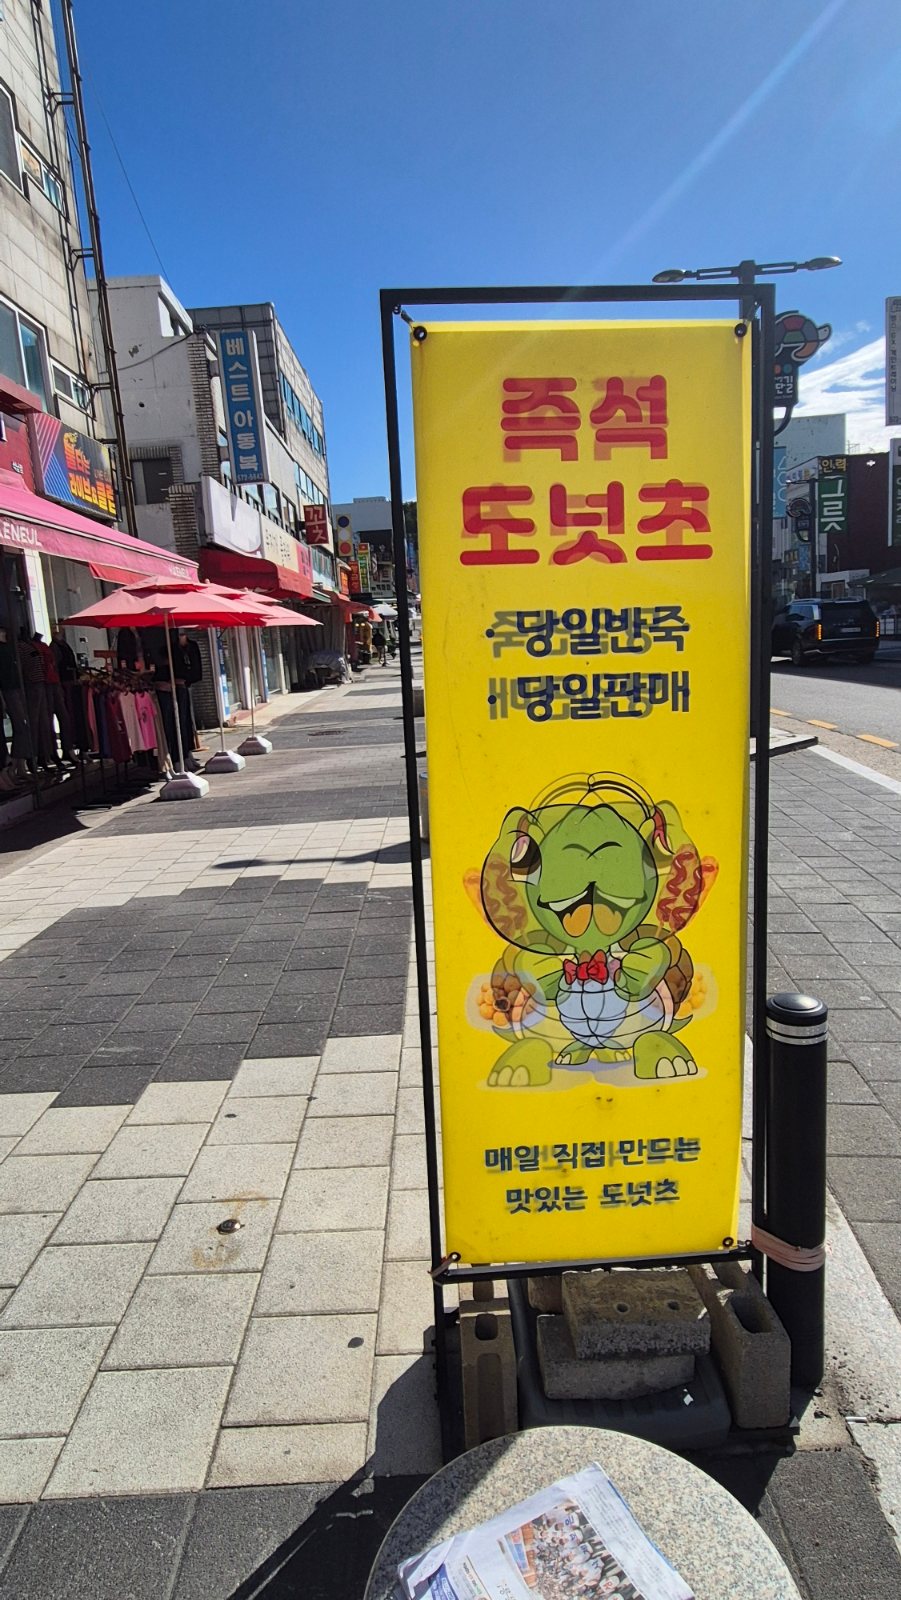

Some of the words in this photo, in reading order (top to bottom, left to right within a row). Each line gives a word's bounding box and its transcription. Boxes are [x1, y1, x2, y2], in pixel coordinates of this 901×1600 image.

[500, 374, 668, 462] 즉석
[459, 478, 714, 566] 도넛츠
[516, 605, 690, 658] 당일반죽
[516, 670, 690, 723] 당일판매
[484, 1144, 540, 1173] 매일
[552, 1140, 606, 1169] 직접
[618, 1136, 702, 1166] 만드는
[506, 1185, 588, 1215] 맛있는
[600, 1178, 681, 1208] 도넛츠
